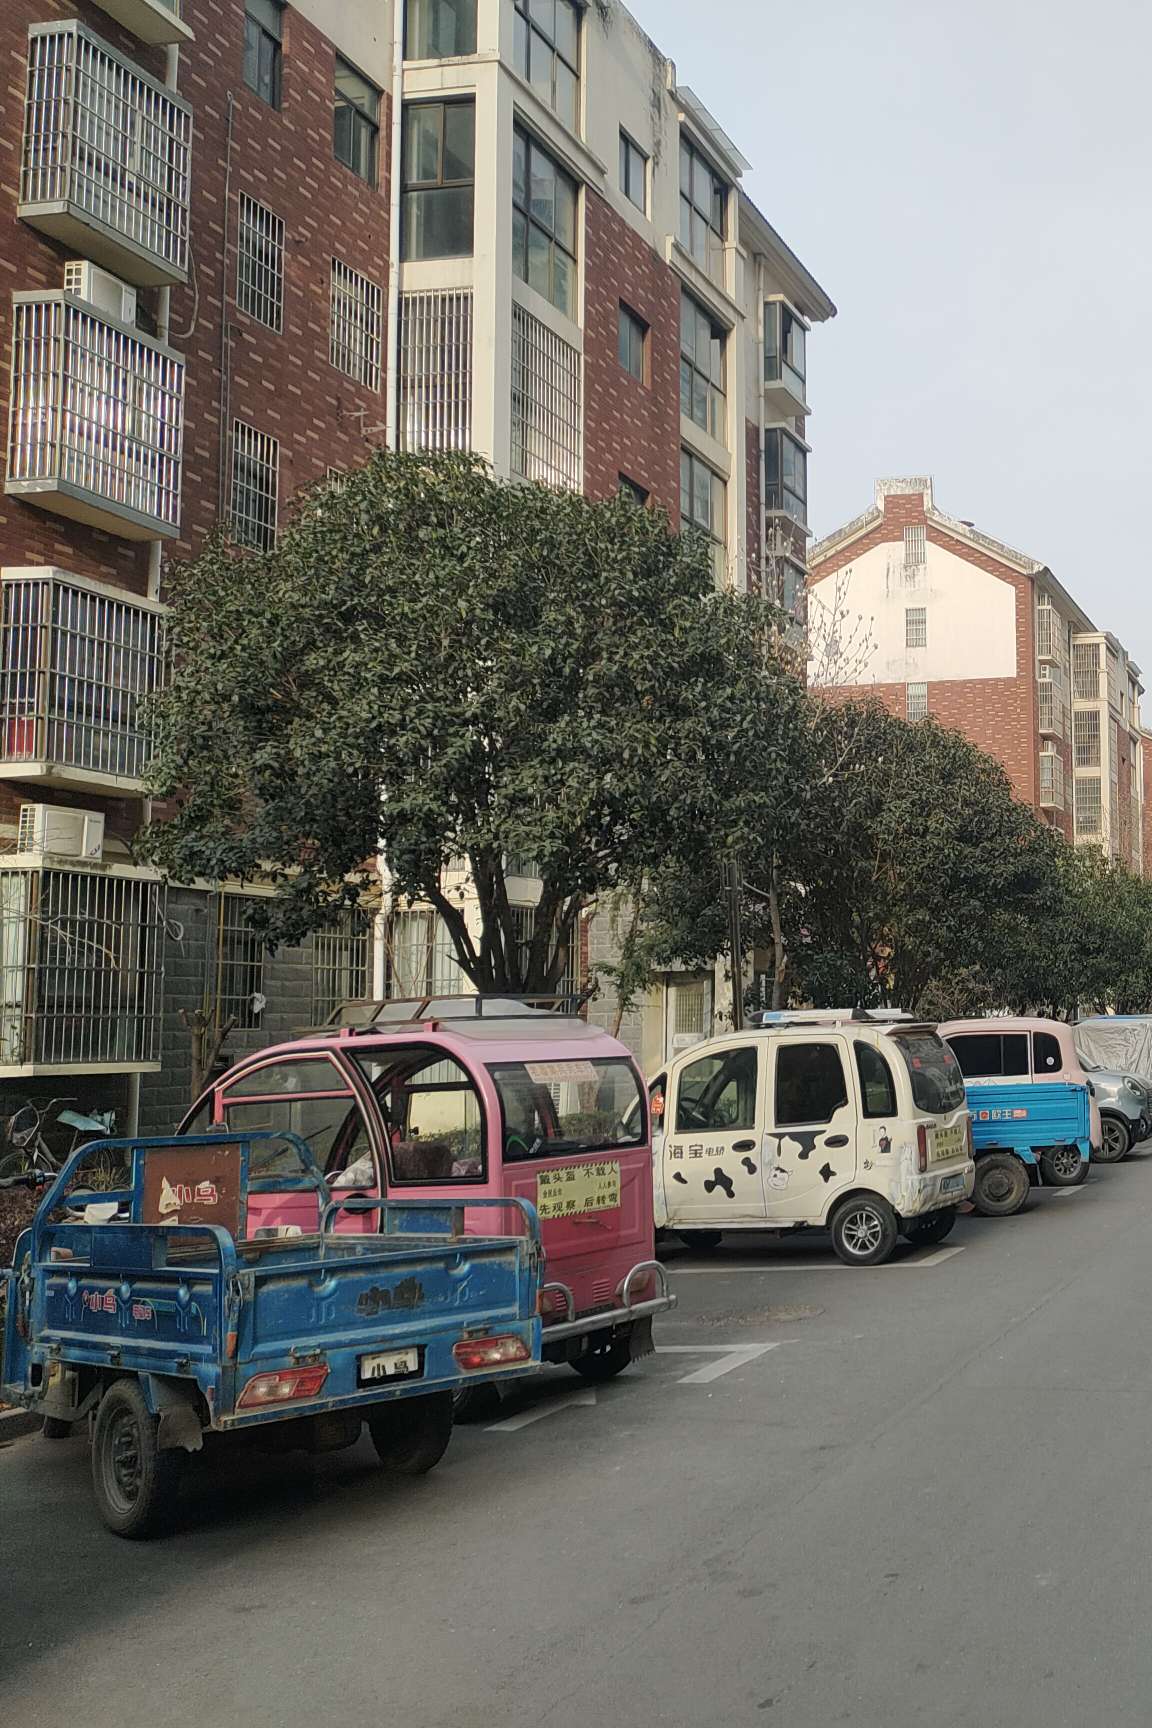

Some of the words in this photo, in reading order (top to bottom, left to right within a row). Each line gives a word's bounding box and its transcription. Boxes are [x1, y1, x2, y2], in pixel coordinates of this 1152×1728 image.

[584, 1166, 617, 1178] 不载人
[539, 1200, 576, 1215] 先观察
[584, 1193, 618, 1207] 后转弯
